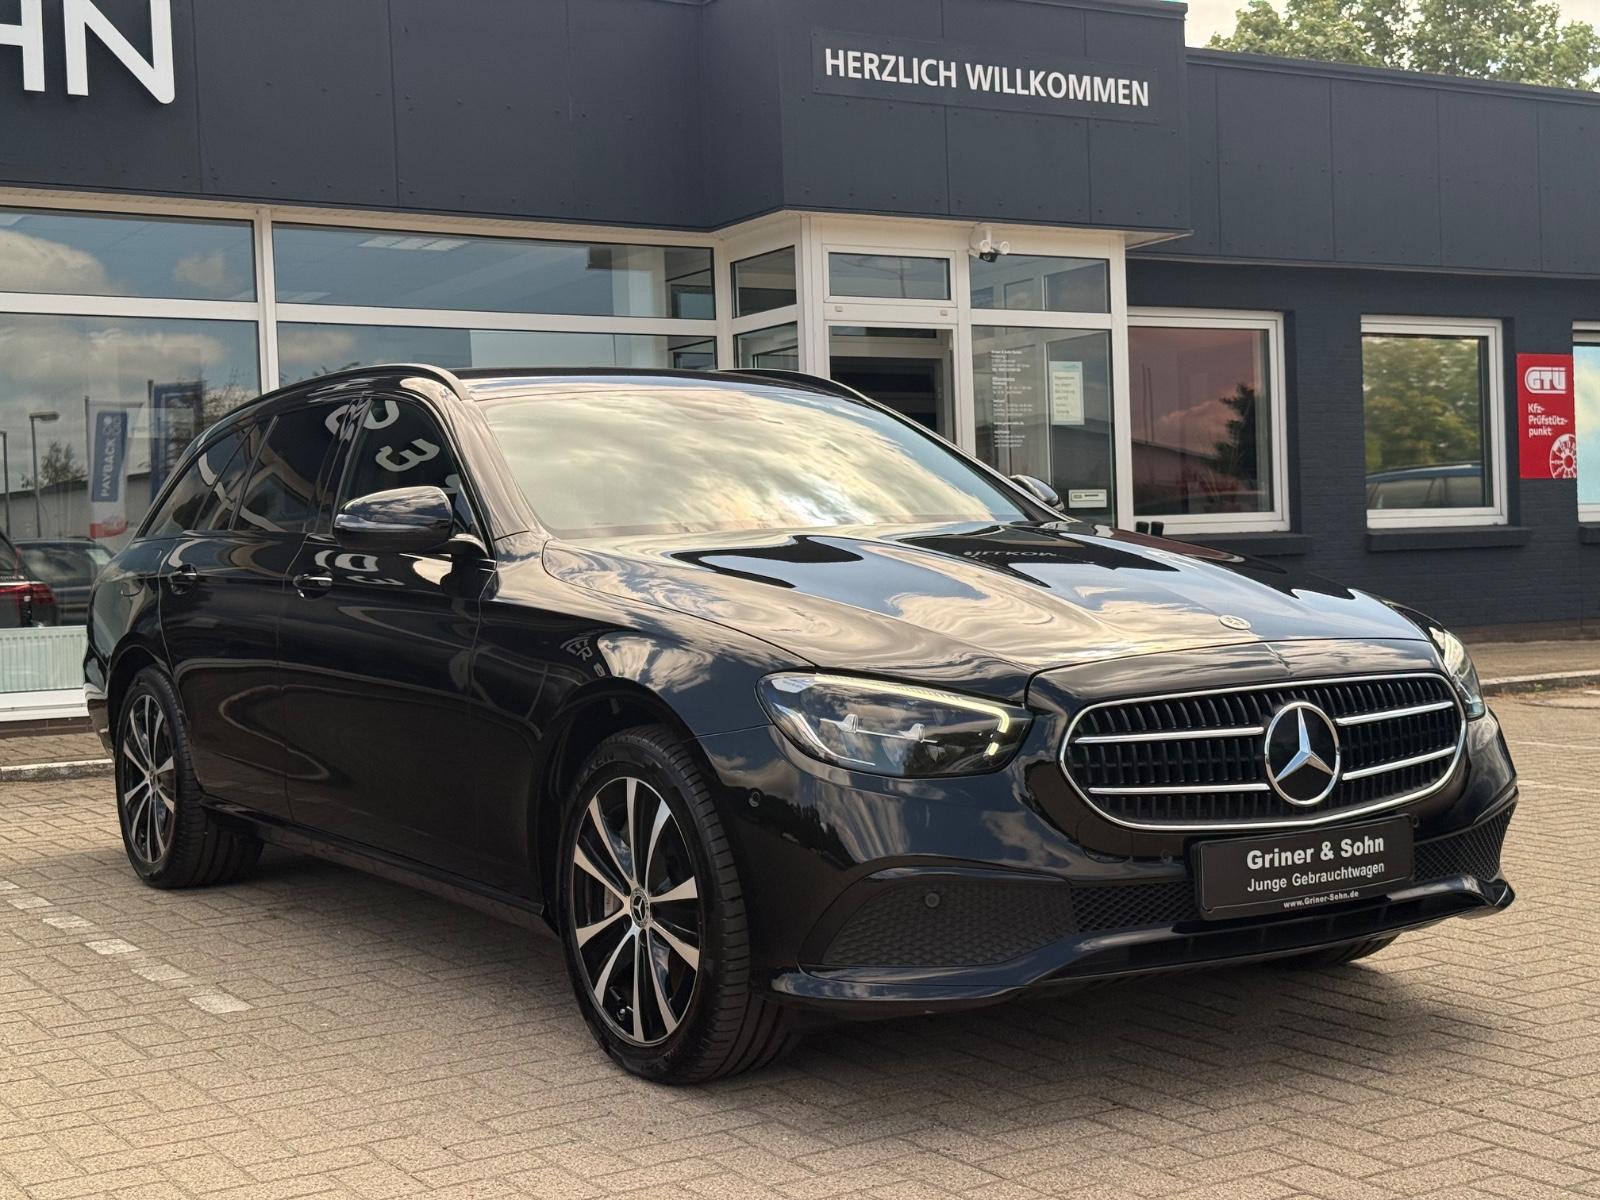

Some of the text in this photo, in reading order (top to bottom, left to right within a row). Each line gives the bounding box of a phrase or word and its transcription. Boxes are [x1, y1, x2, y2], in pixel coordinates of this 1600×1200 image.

[825, 48, 1149, 107] HERZLICH WILLKOMMEN
[1527, 403, 1546, 414] Kfz-
[1528, 426, 1552, 438] punkt
[100, 438, 117, 497] PAYBACK
[1246, 835, 1384, 870] Griner & Sohn
[1247, 862, 1385, 893] Junge Gebrauchtwagen
